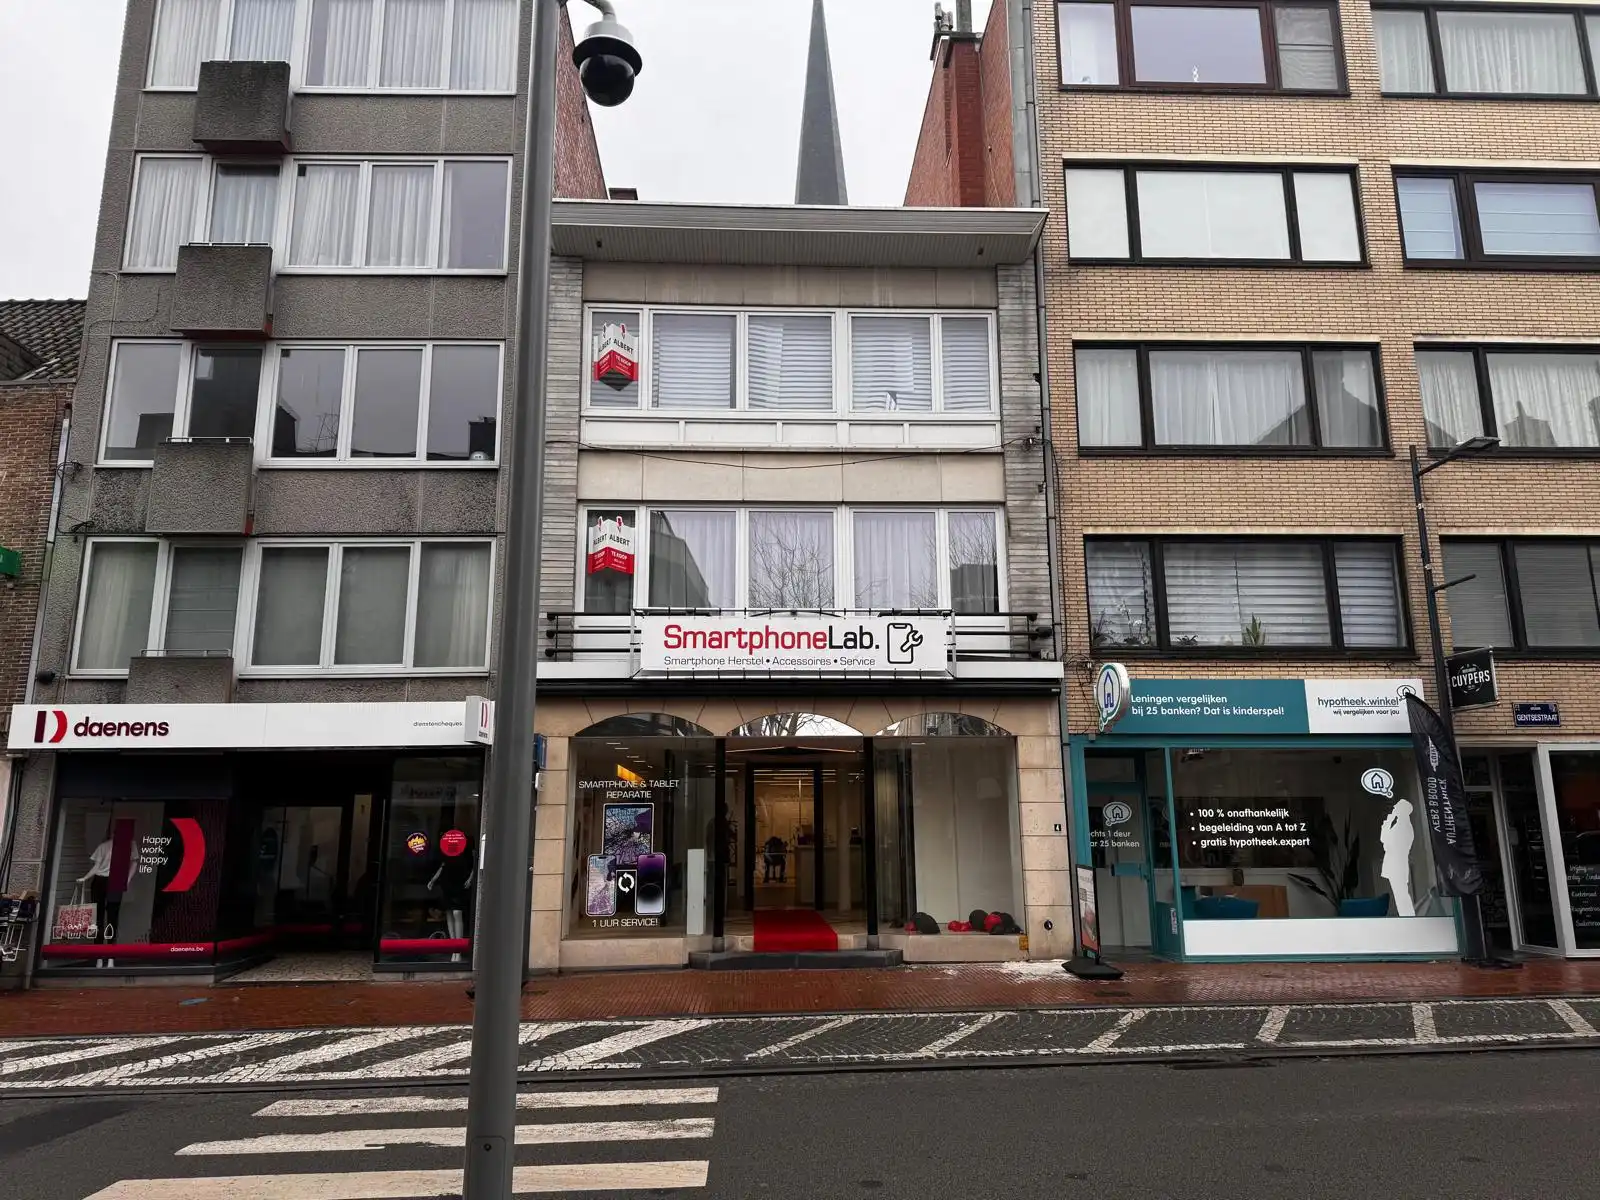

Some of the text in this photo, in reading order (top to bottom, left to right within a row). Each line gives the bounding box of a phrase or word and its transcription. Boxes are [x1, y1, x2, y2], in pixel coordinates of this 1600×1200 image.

[613, 338, 634, 354] ALBERT
[609, 534, 630, 546] ALBERT
[663, 624, 880, 655] SmartphoneLab.
[664, 656, 876, 667] Smartphone Herstel Accessoires Service
[1451, 669, 1491, 688] CUYPERS
[1131, 694, 1228, 705] Leningen vergelijken
[1317, 696, 1399, 708] hypotheek.winkel
[1131, 706, 1285, 717] bij 25 banken? Dat is kinderspel!
[1333, 708, 1342, 716] wij
[1343, 708, 1375, 716] vergelijken
[1390, 708, 1400, 716] jou
[1516, 713, 1558, 722] GENTSESTRAAT
[73, 716, 169, 737] daenens
[578, 780, 680, 789] SMARTPHONE & TABLET
[606, 790, 652, 799] REPARATIE
[1198, 808, 1290, 819] 100 % onafhankelijk
[1089, 830, 1106, 838] chts
[1113, 830, 1132, 838] deur
[1199, 823, 1307, 834] begeleiding van A tot Z
[142, 836, 172, 846] Happy
[1111, 840, 1140, 848] banken
[1200, 837, 1310, 848] gratis hypotheek.expert
[141, 846, 165, 855] work,
[140, 856, 168, 866] happy
[139, 865, 153, 873] life
[592, 917, 658, 928] 1 UUR SERVICE!
